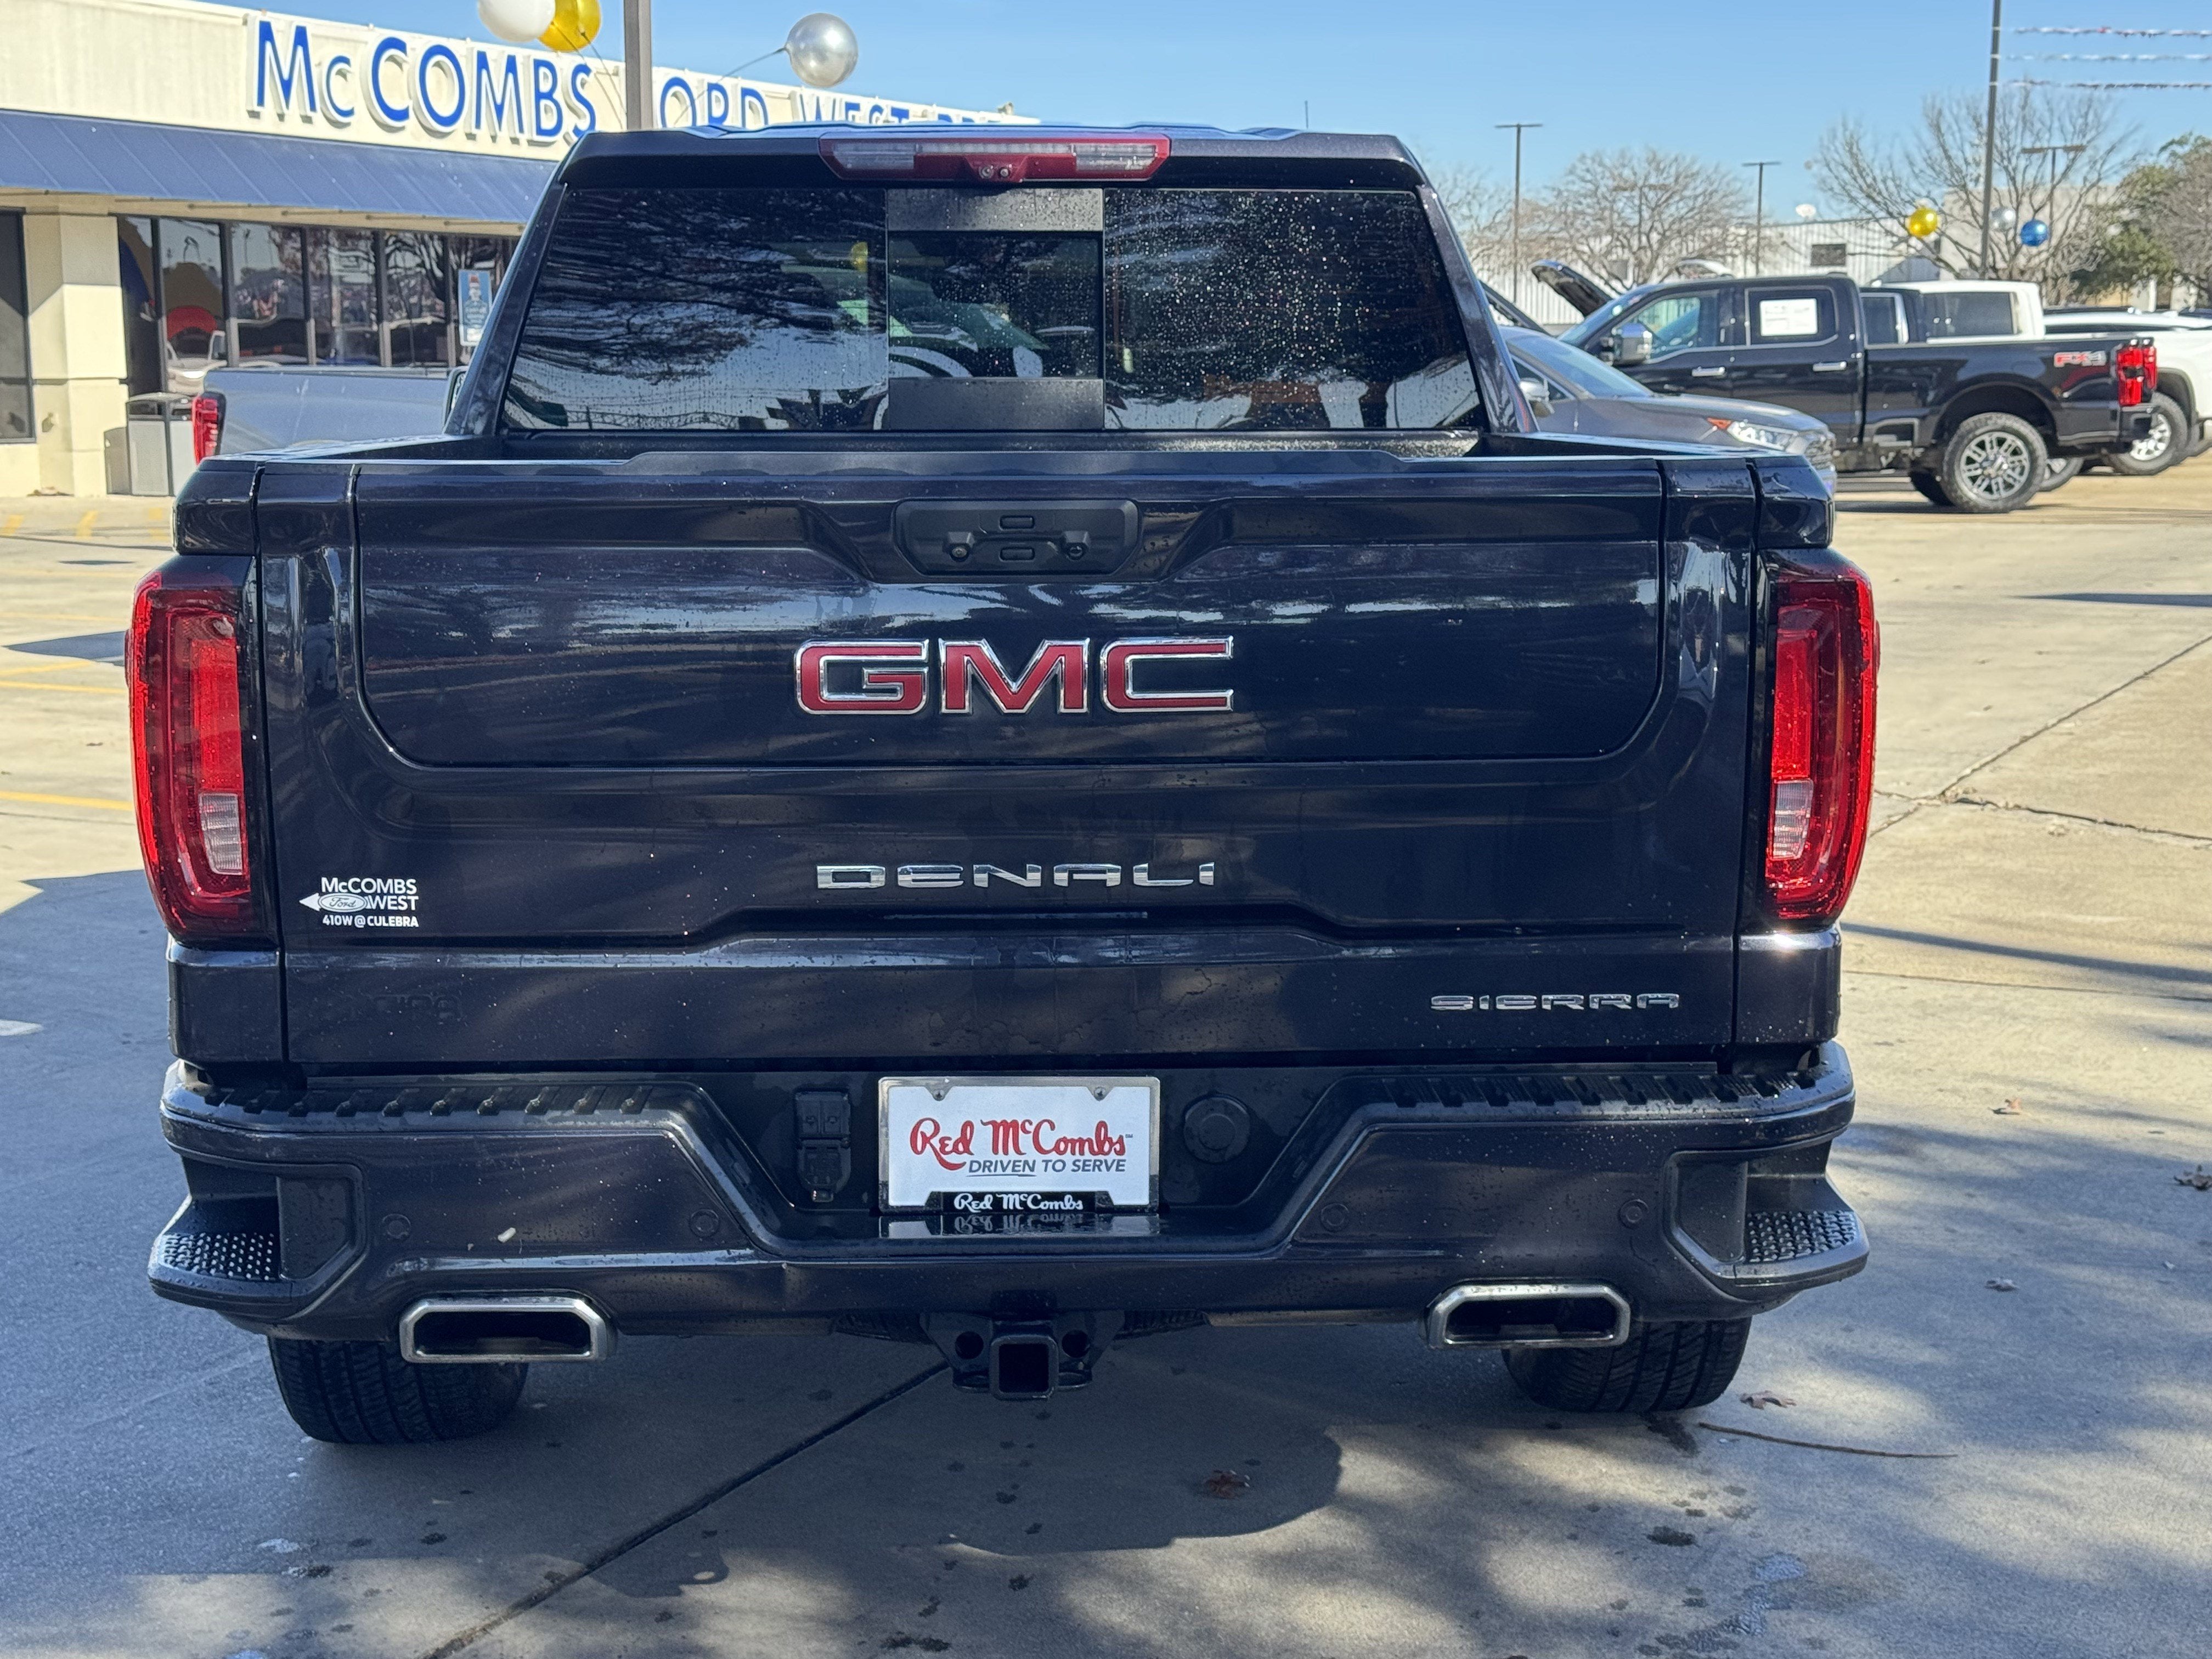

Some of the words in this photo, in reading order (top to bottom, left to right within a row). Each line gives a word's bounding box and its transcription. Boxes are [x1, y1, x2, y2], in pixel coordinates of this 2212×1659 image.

[256, 20, 596, 139] McCOMBS
[660, 76, 769, 129] ORD
[793, 635, 1234, 715] GMC
[816, 861, 1215, 889] DENALI
[321, 877, 417, 894] McCOMBS
[329, 897, 357, 908] Ford
[368, 895, 419, 911] WEST
[1431, 993, 1680, 1010] SIERRA
[910, 1117, 975, 1171] Red
[968, 1160, 1036, 1173] DRIVEN
[1042, 1159, 1066, 1173] TO
[1070, 1159, 1127, 1173] SERVE
[953, 1193, 994, 1213] Red
